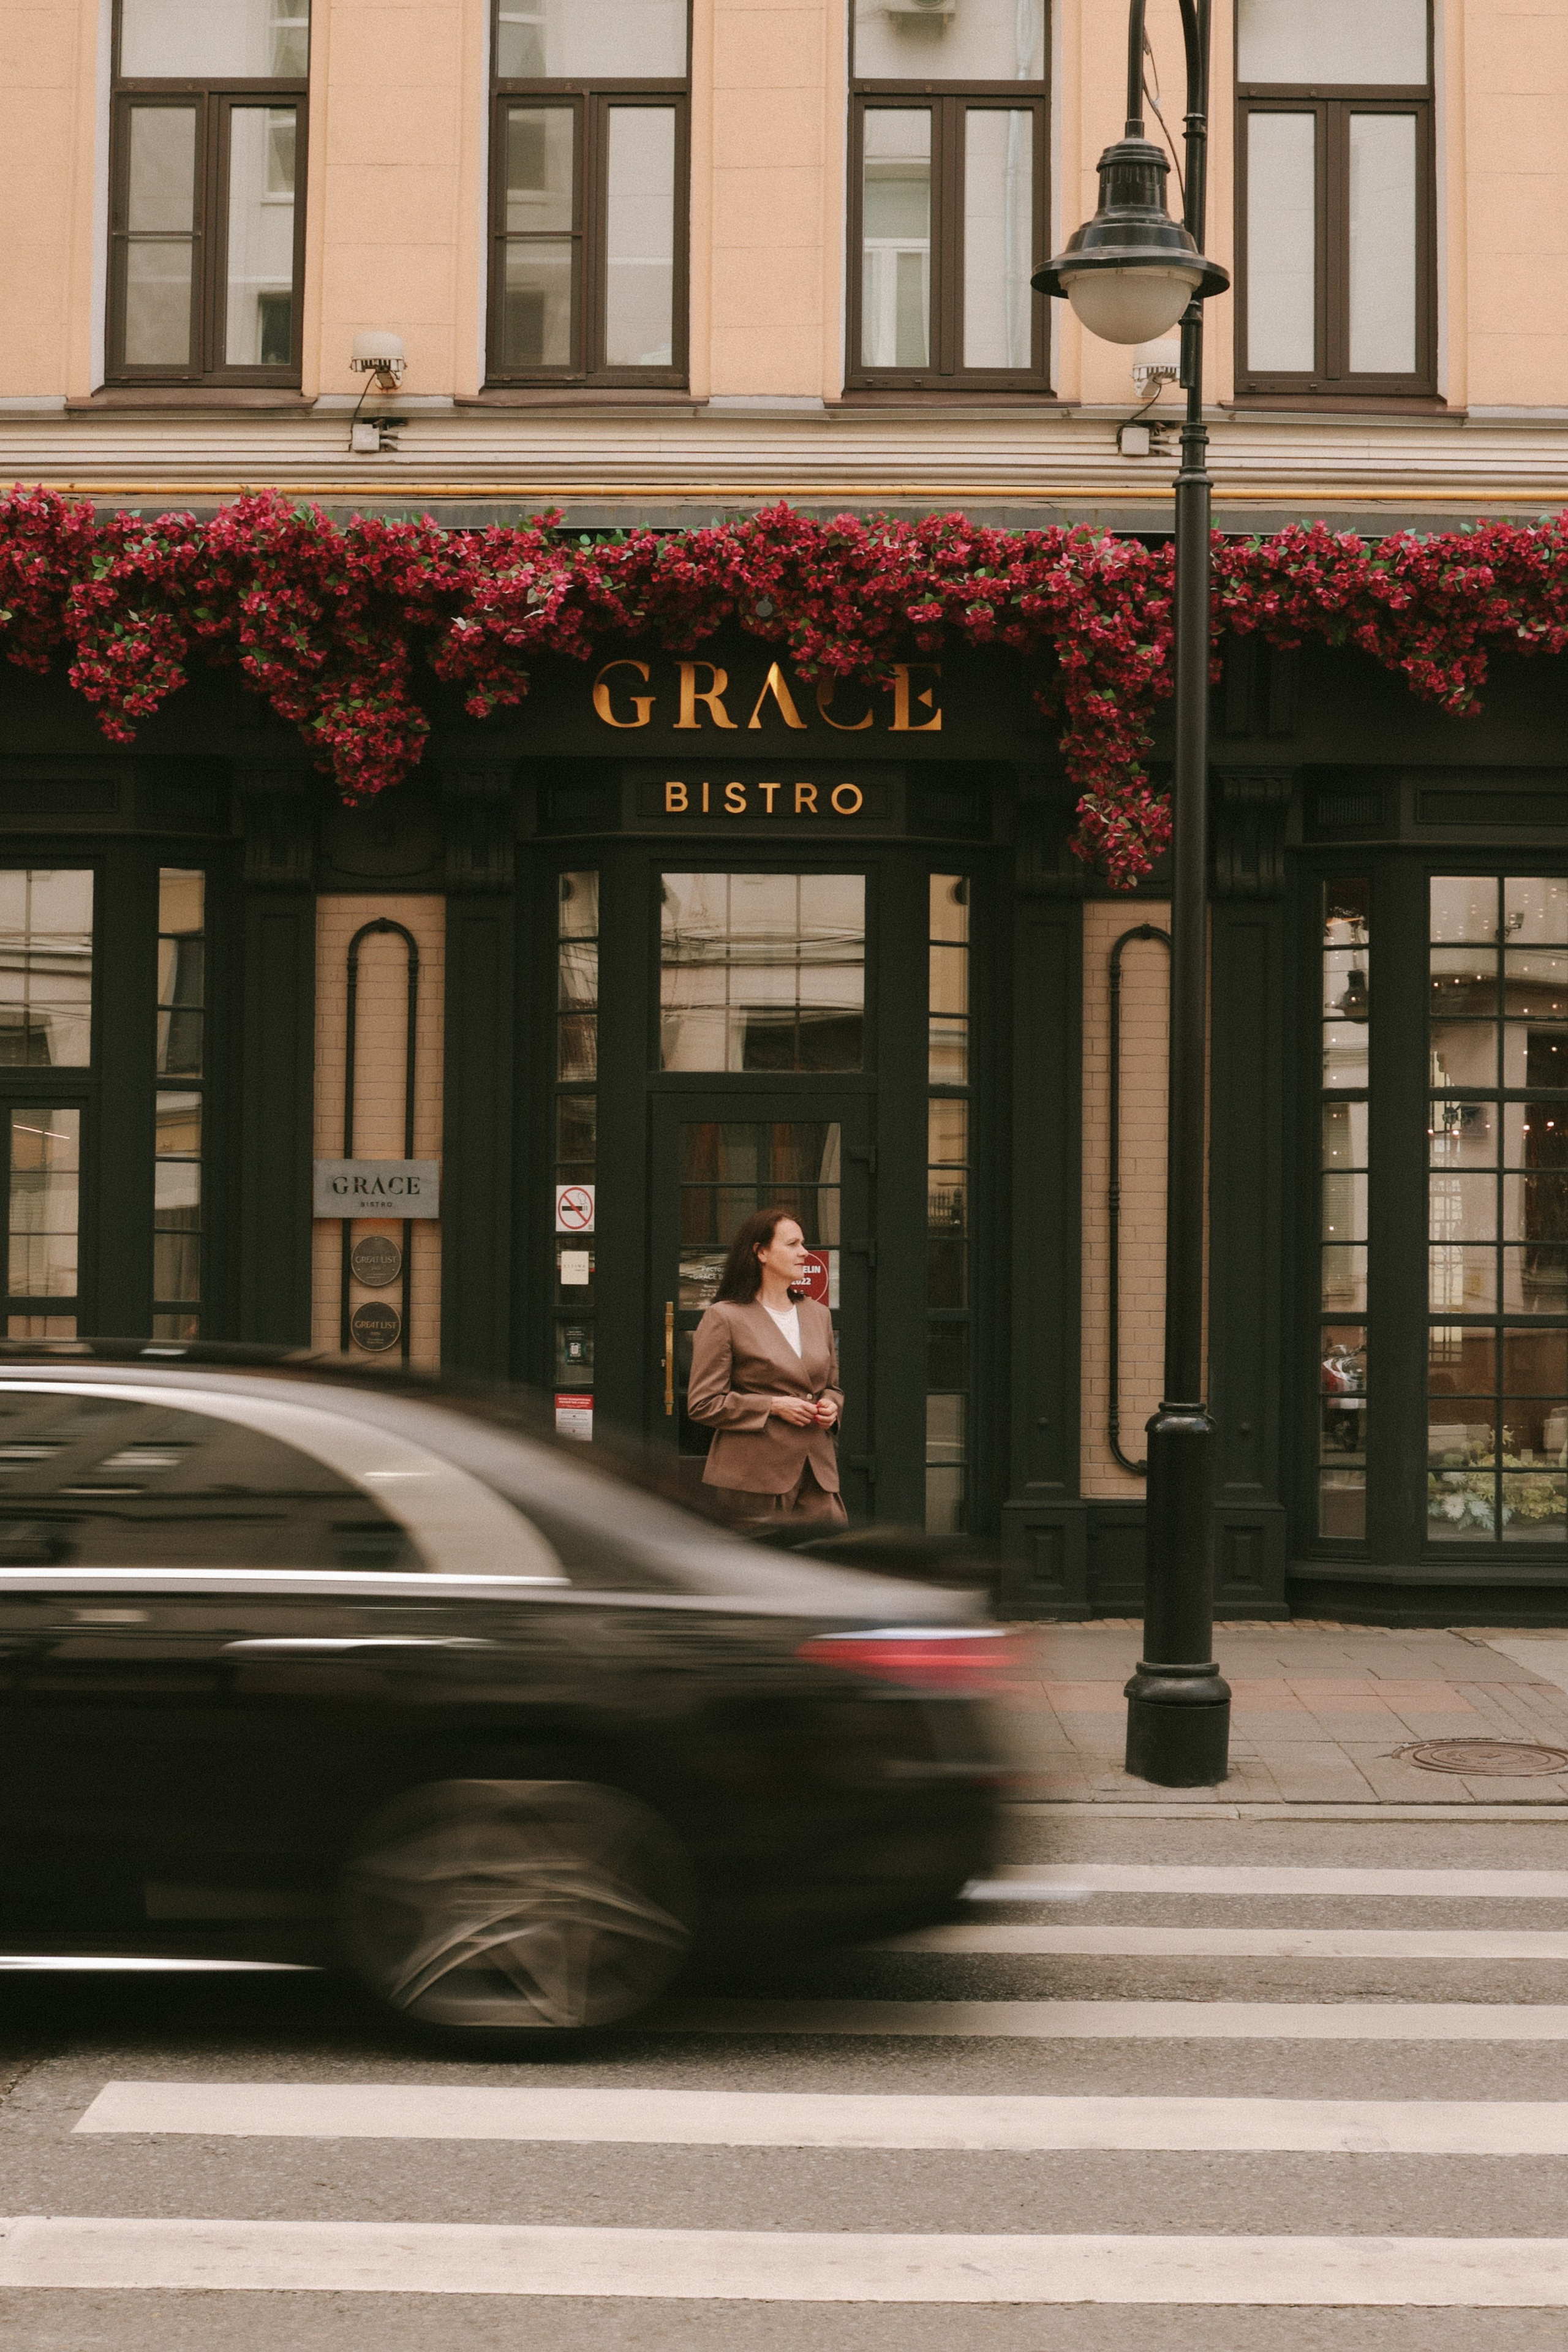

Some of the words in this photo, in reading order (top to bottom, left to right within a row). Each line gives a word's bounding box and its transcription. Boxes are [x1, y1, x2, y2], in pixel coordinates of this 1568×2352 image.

[592, 659, 942, 731] GRACE
[665, 782, 863, 815] BISTRO
[333, 1176, 420, 1195] GRACE
